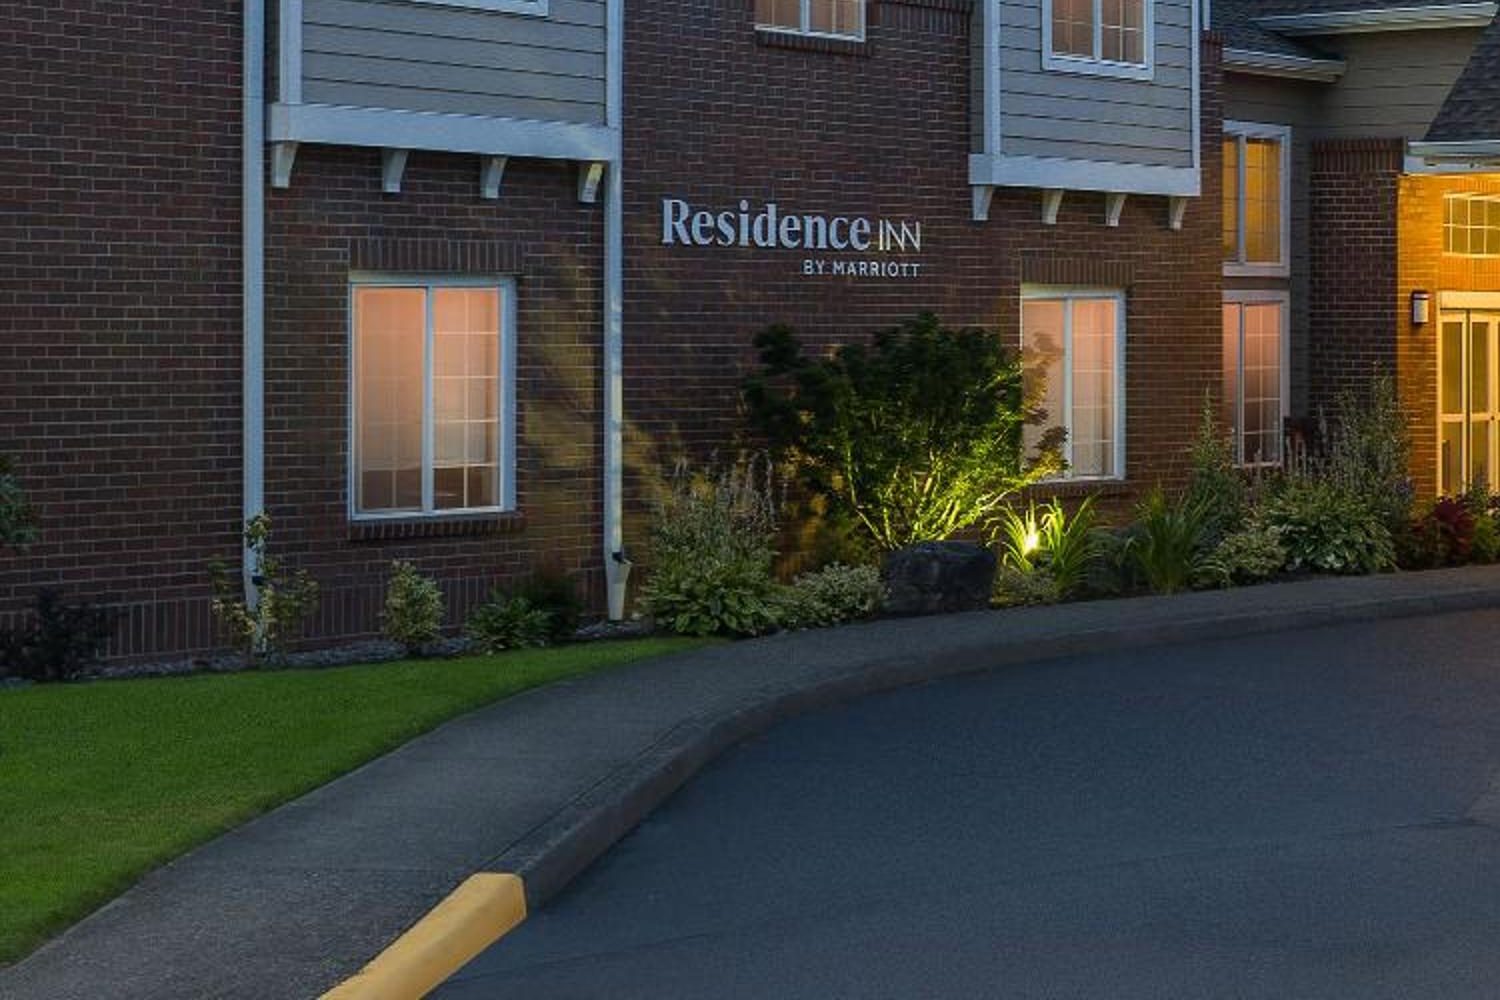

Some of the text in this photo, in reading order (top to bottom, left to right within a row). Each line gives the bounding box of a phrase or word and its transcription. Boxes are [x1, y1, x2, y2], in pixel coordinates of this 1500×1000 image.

[661, 198, 920, 251] Residence INN
[803, 259, 920, 278] BY MARRIOTT
